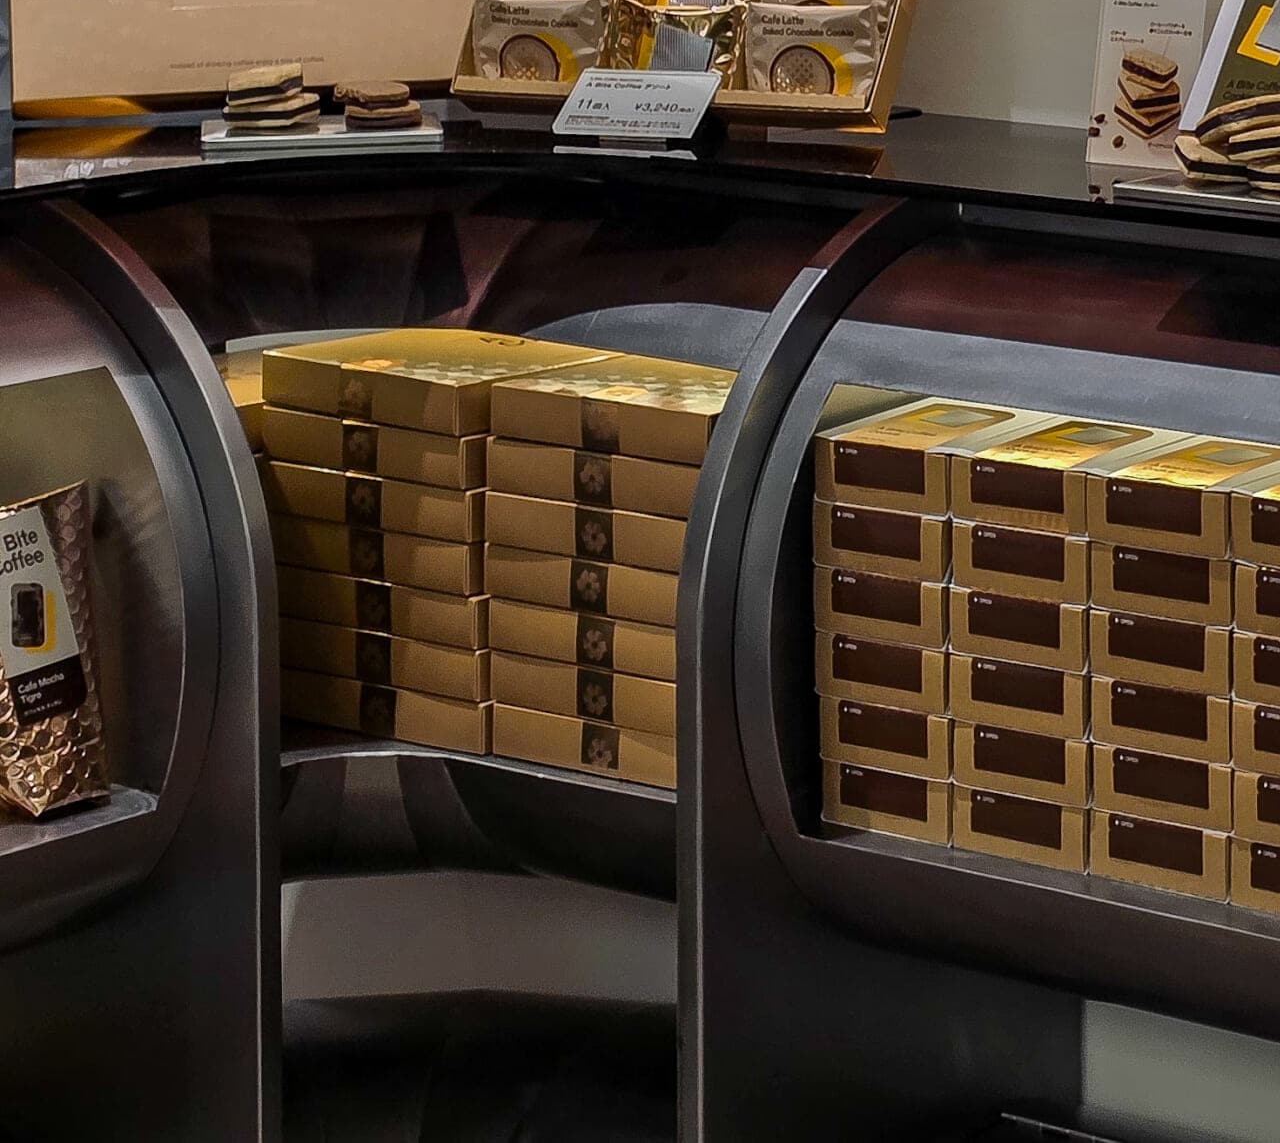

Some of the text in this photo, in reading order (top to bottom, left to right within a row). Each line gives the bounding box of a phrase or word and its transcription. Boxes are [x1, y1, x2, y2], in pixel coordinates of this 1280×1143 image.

[3, 529, 39, 552] Bite
[0, 550, 45, 576] offee
[17, 680, 38, 695] Cafe
